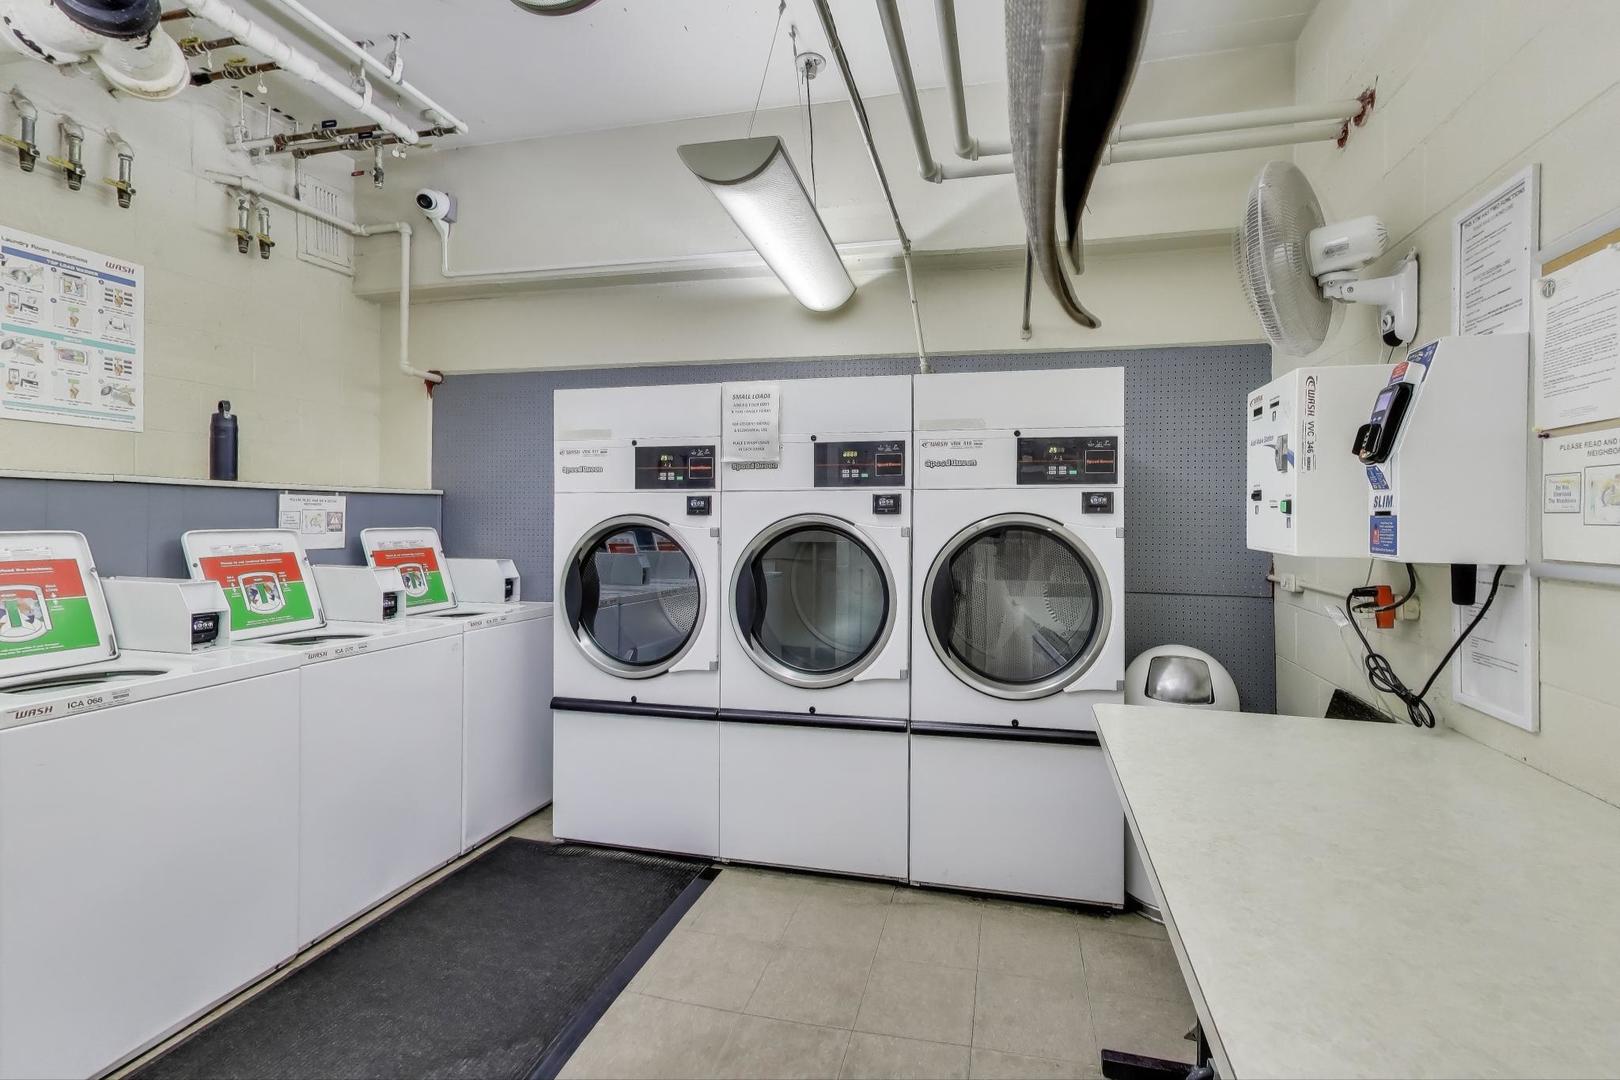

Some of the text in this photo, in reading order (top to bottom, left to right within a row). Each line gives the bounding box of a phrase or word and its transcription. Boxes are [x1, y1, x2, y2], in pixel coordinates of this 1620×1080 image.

[105, 261, 135, 275] WASH
[1307, 389, 1316, 416] WASH
[1560, 438, 1618, 451] PLEASE READ AND
[1374, 495, 1393, 508] SLIM
[15, 705, 53, 720] WASH
[67, 700, 84, 709] ICA
